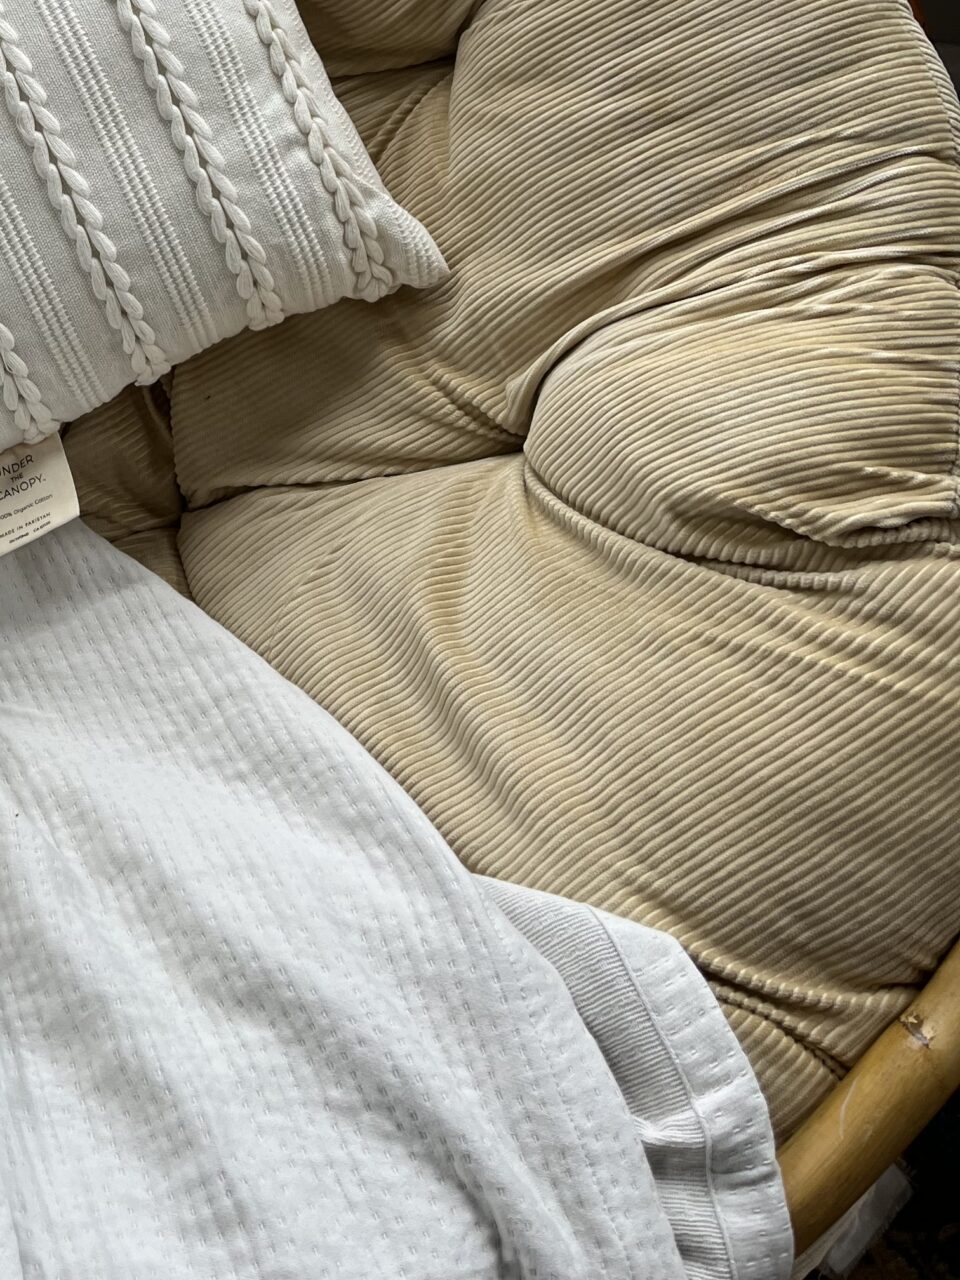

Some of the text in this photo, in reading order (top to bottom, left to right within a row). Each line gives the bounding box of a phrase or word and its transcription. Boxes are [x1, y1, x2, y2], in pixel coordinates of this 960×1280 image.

[10, 472, 24, 483] THE
[14, 503, 34, 515] Organic
[34, 494, 53, 505] Cotton
[0, 528, 15, 539] MADE
[25, 512, 51, 527] PAKISTAN
